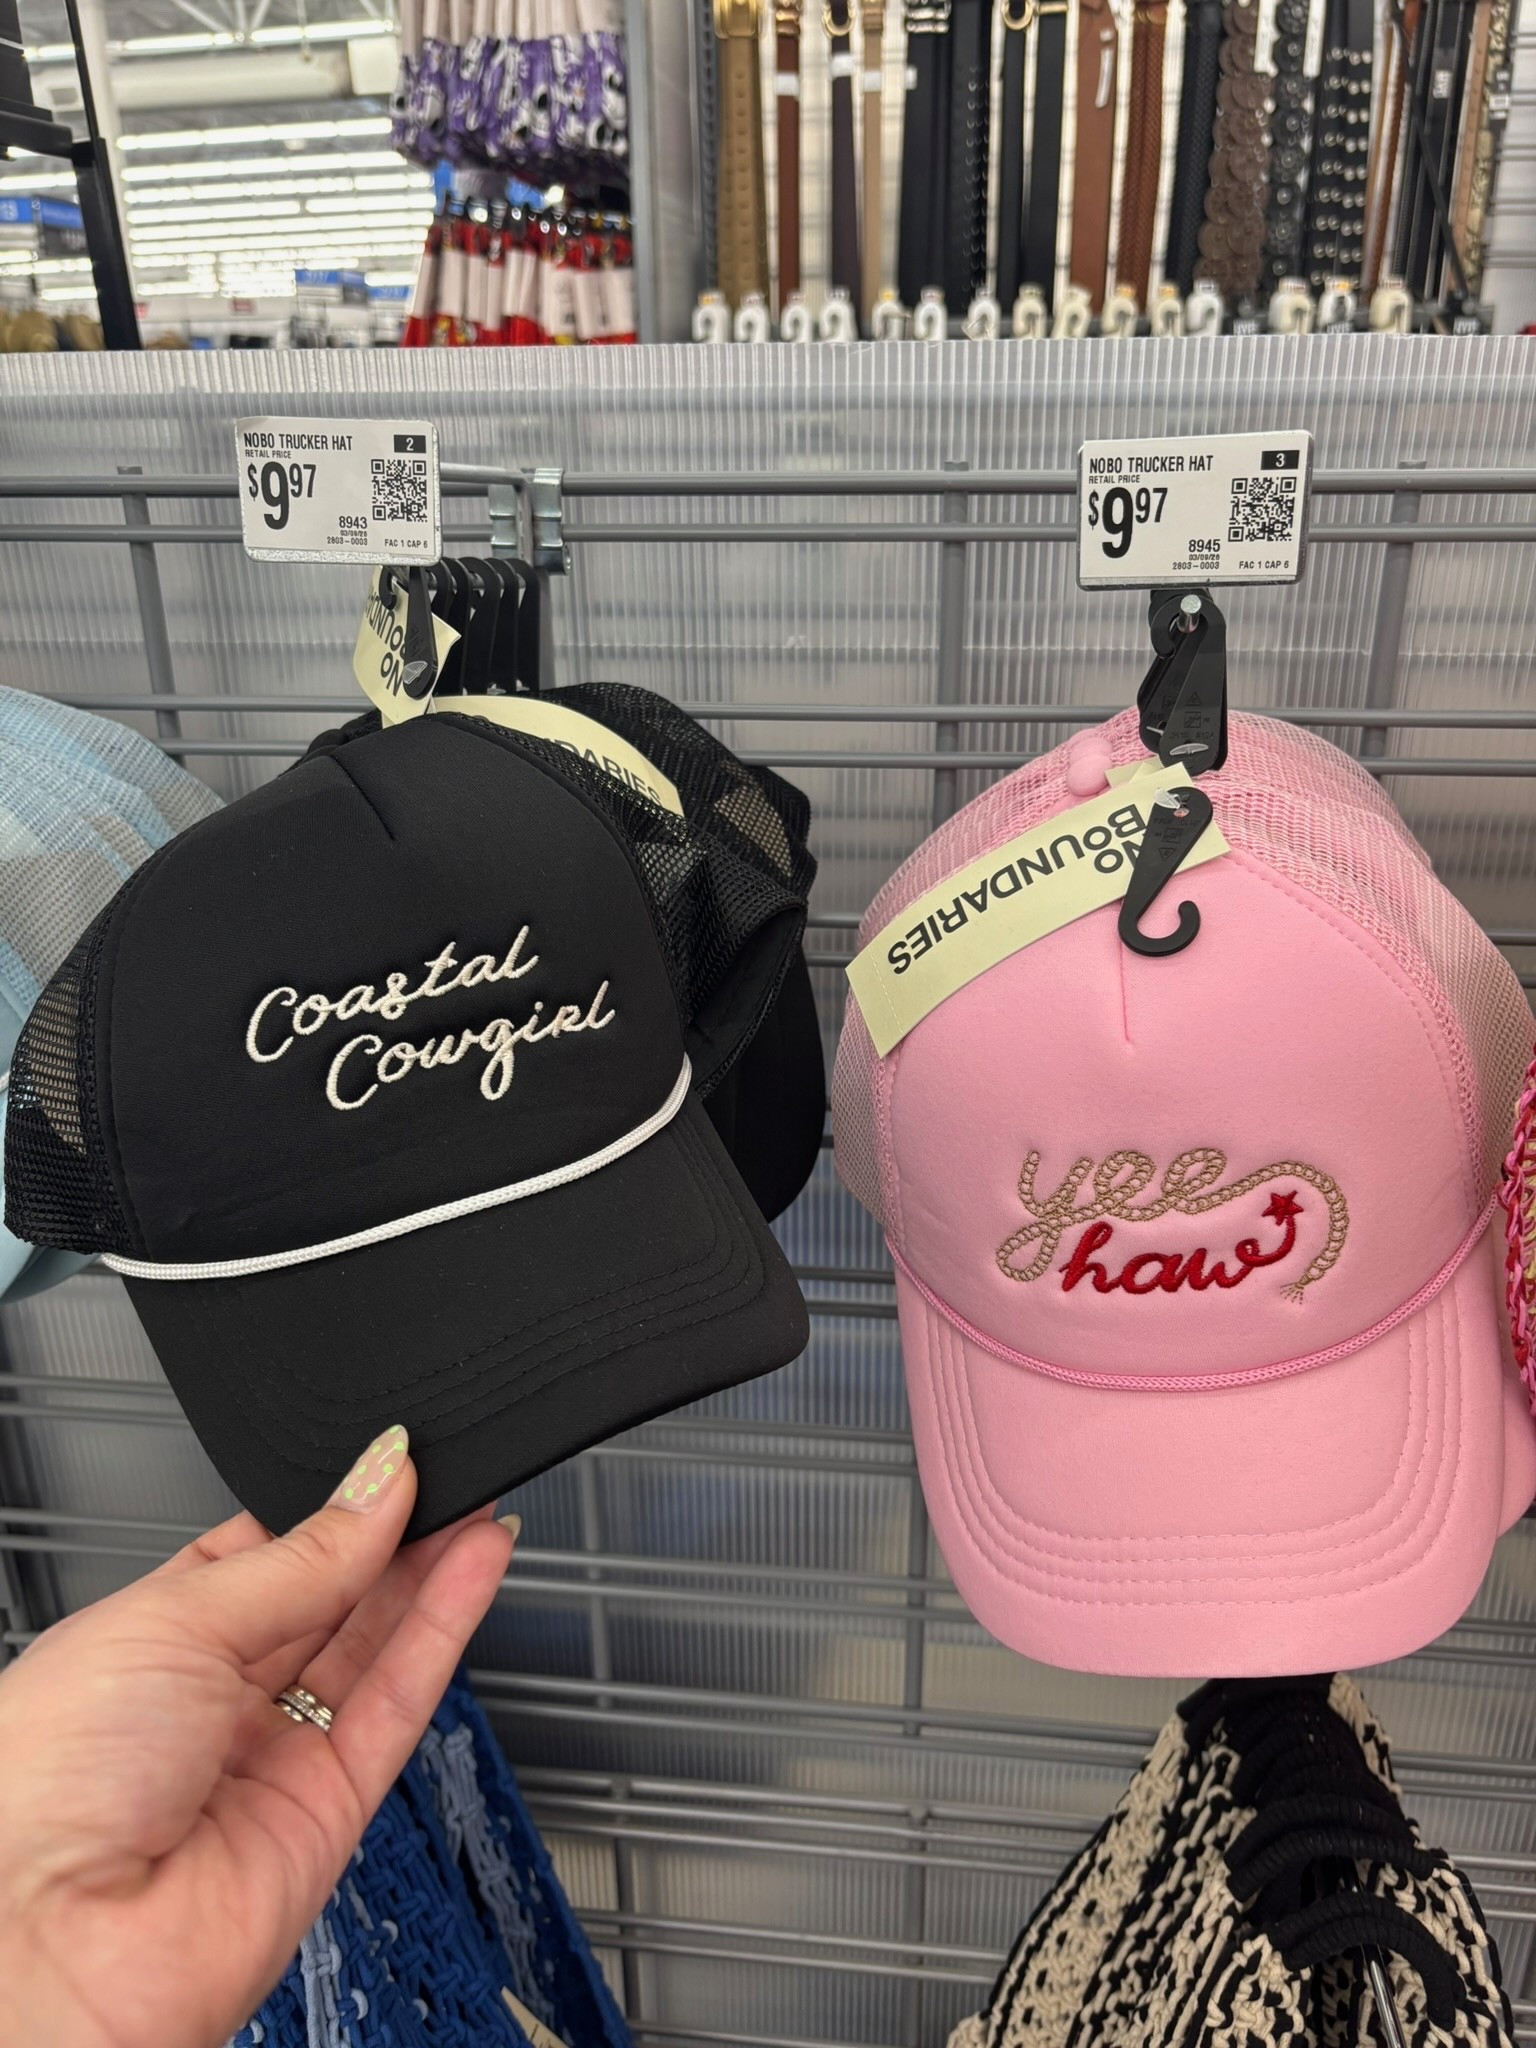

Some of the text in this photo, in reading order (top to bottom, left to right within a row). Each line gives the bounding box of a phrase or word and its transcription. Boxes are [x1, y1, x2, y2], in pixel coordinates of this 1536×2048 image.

[243, 433, 352, 450] NOBO TRUCKER HAT
[405, 438, 414, 451] 2
[245, 449, 292, 459] RETAIL PRICE
[1275, 453, 1286, 467] 3
[1089, 455, 1214, 474] NOBO TRUCKER HAT
[1089, 474, 1140, 484] RETAIL PRICE
[339, 516, 368, 529] 8943
[384, 539, 398, 547] FAC
[407, 540, 421, 548] CAP
[1188, 539, 1221, 552] 8945
[1239, 561, 1255, 569] FAC
[1265, 560, 1281, 569] CAP
[380, 651, 404, 697] NO
[887, 804, 1148, 975] BOUNDARIES
[246, 924, 540, 1064] Coastal
[326, 979, 616, 1111] Cowgirl
[1059, 1221, 1297, 1295] haw
